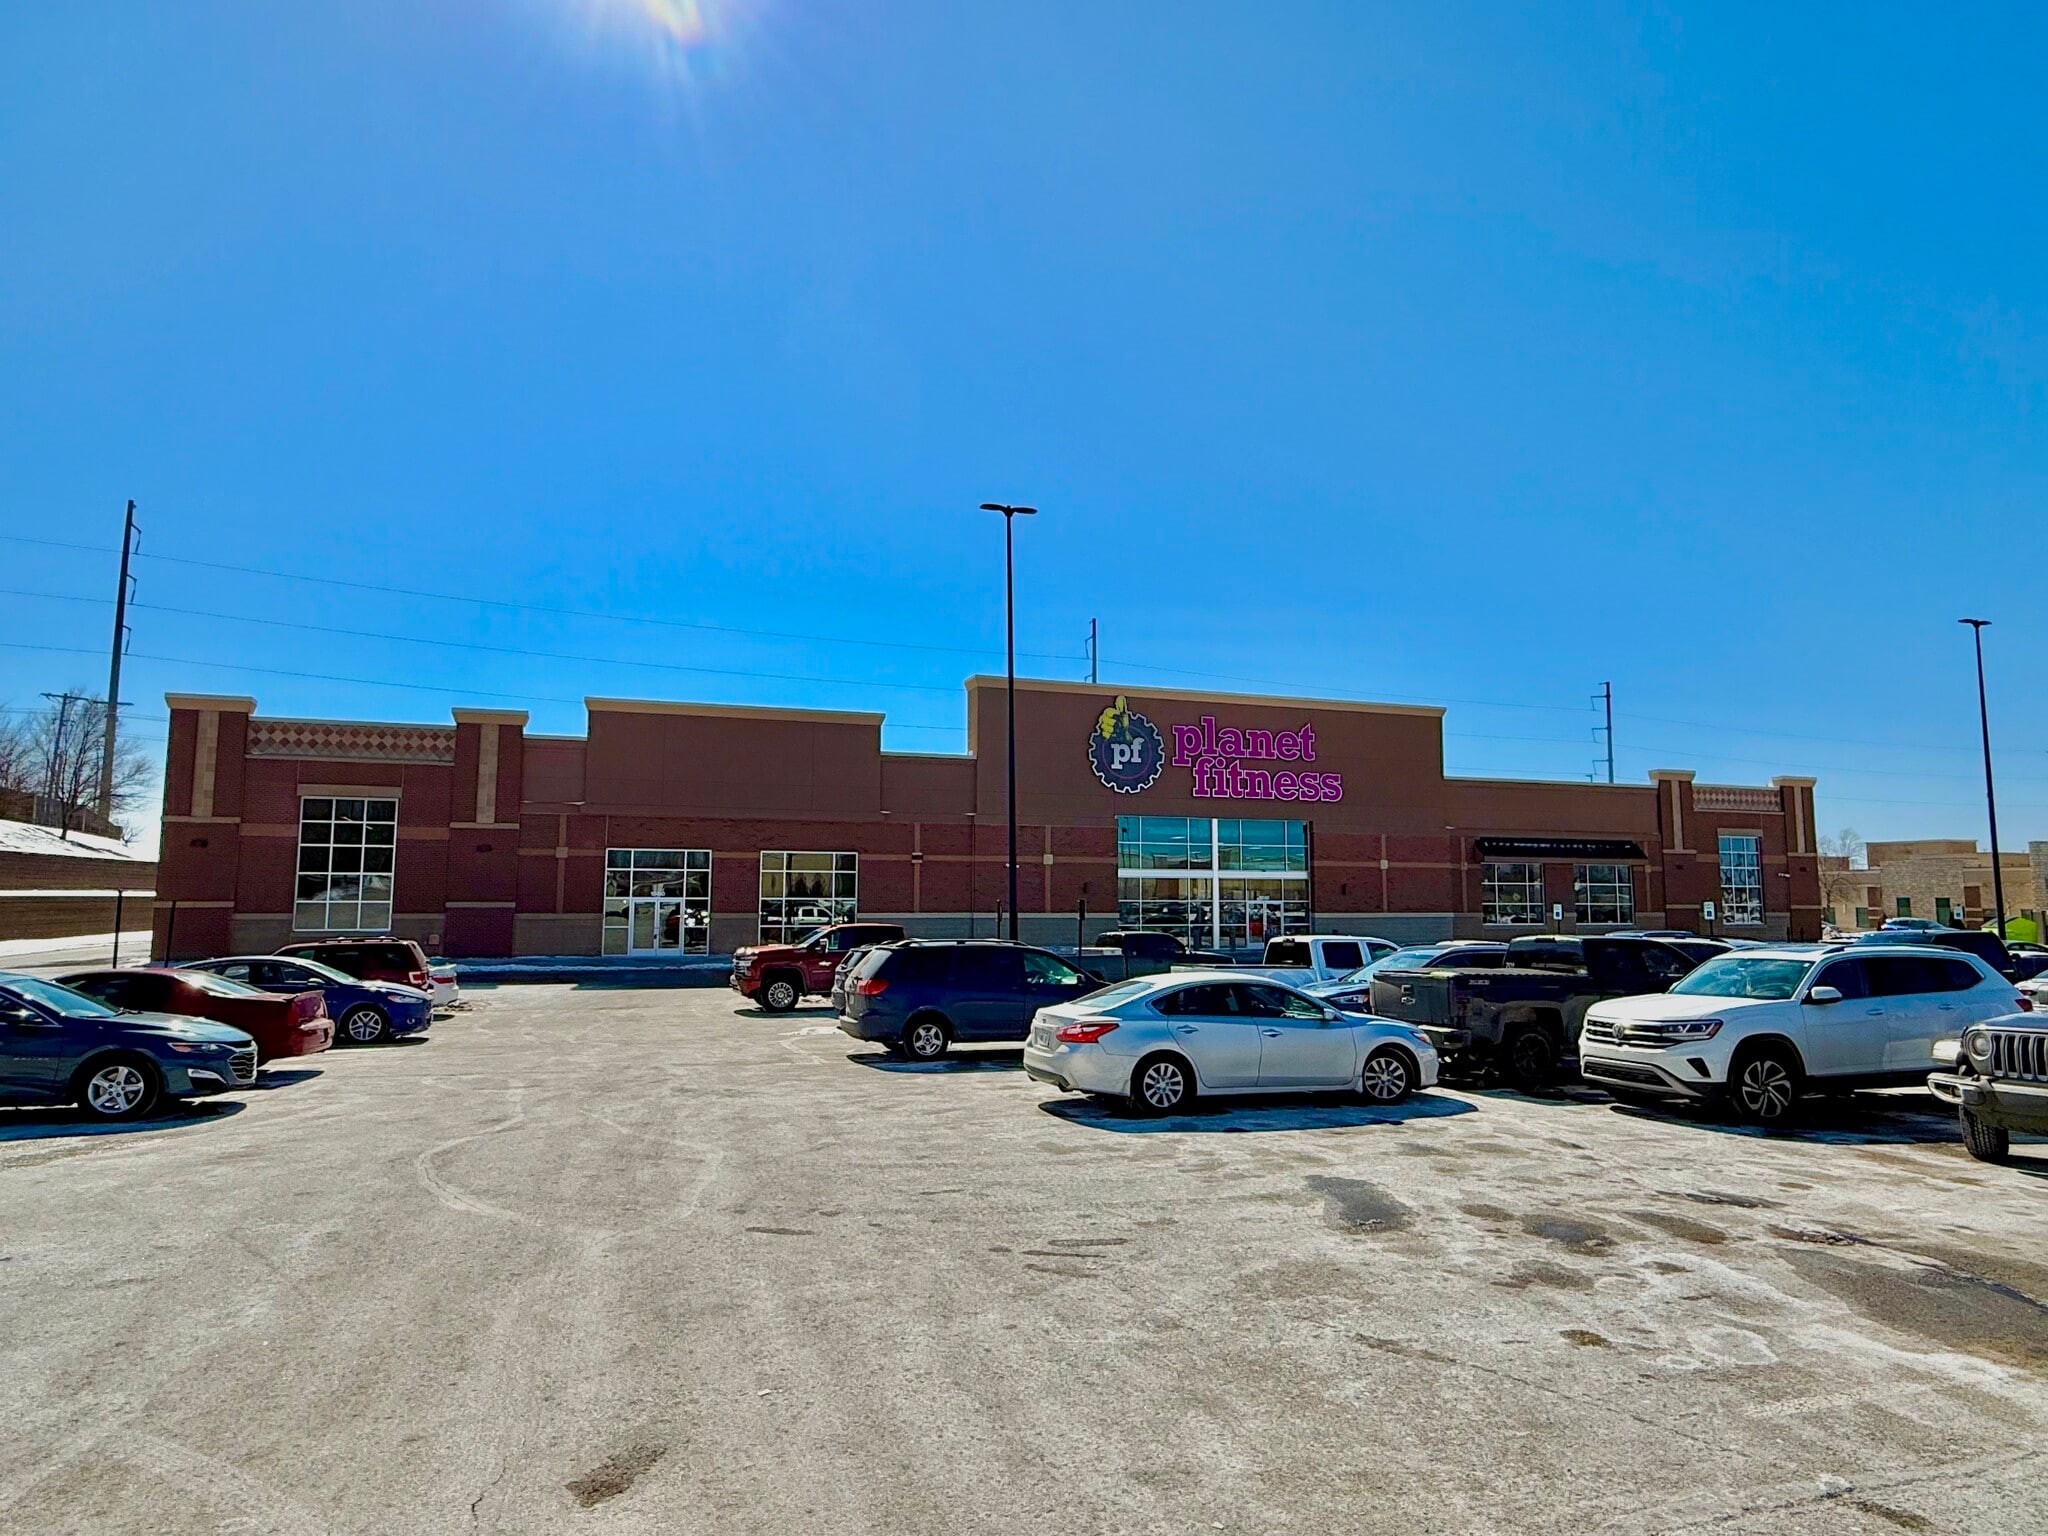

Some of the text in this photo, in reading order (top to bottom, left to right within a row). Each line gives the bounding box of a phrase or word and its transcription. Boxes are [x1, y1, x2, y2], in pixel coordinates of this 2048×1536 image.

[1110, 737, 1145, 770] pf
[1172, 716, 1316, 767] planet
[1192, 757, 1343, 803] fitness
